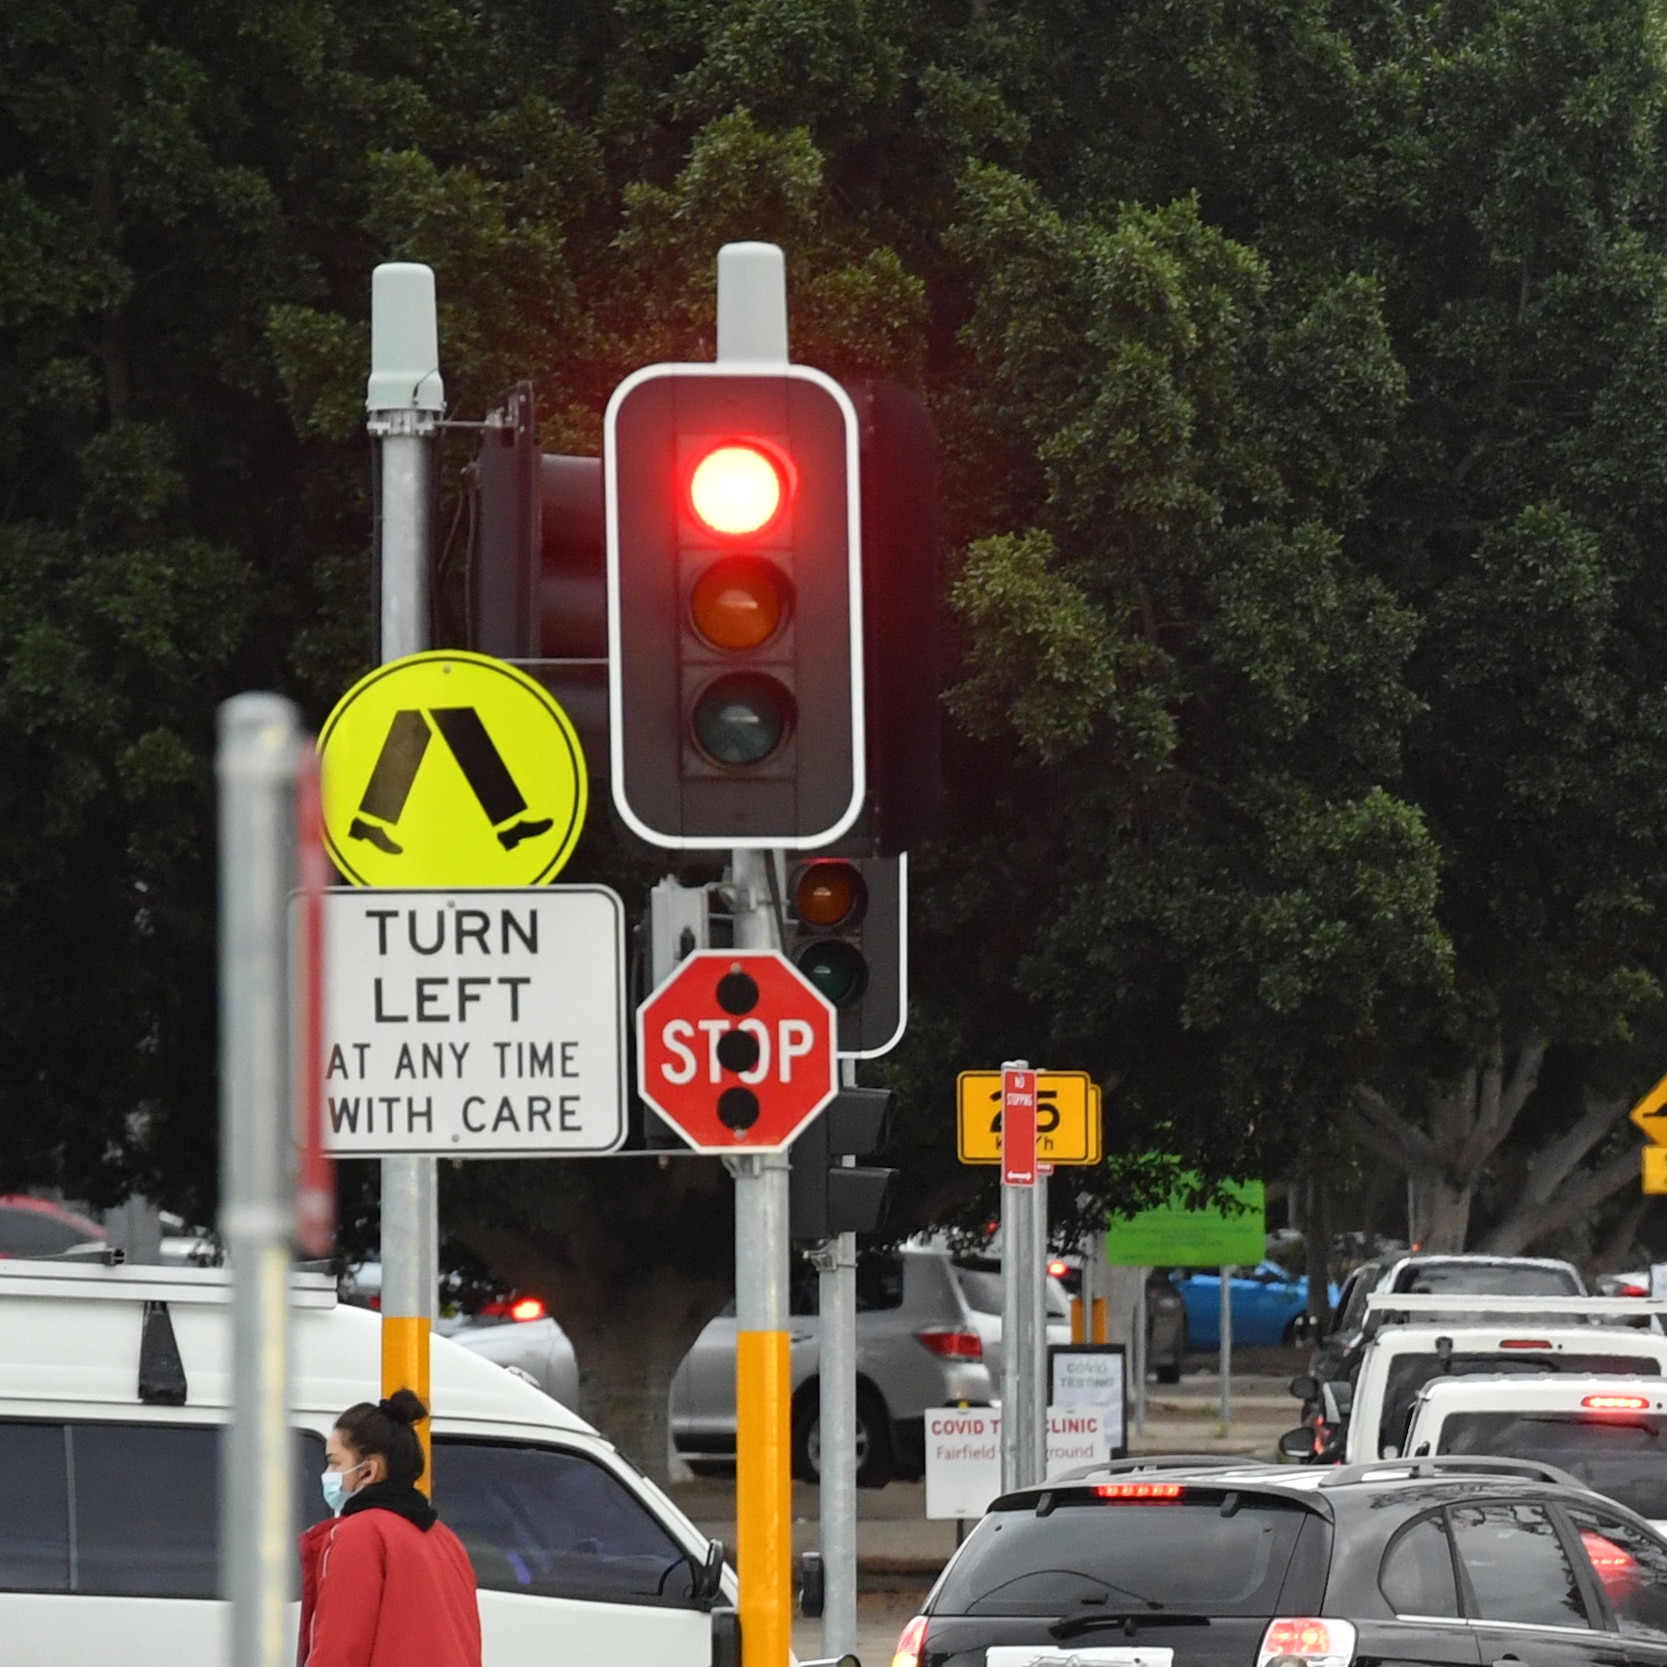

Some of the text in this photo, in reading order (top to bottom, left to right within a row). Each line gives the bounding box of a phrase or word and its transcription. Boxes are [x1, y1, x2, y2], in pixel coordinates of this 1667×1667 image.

[365, 908, 539, 956] TURN
[374, 976, 532, 1023] LEFT
[326, 1041, 580, 1080] AT ANY TIME
[660, 1017, 815, 1085] STOP
[328, 1095, 583, 1134] WITH CARE
[931, 1419, 985, 1435] COVID
[936, 1444, 995, 1460] Fairfield
